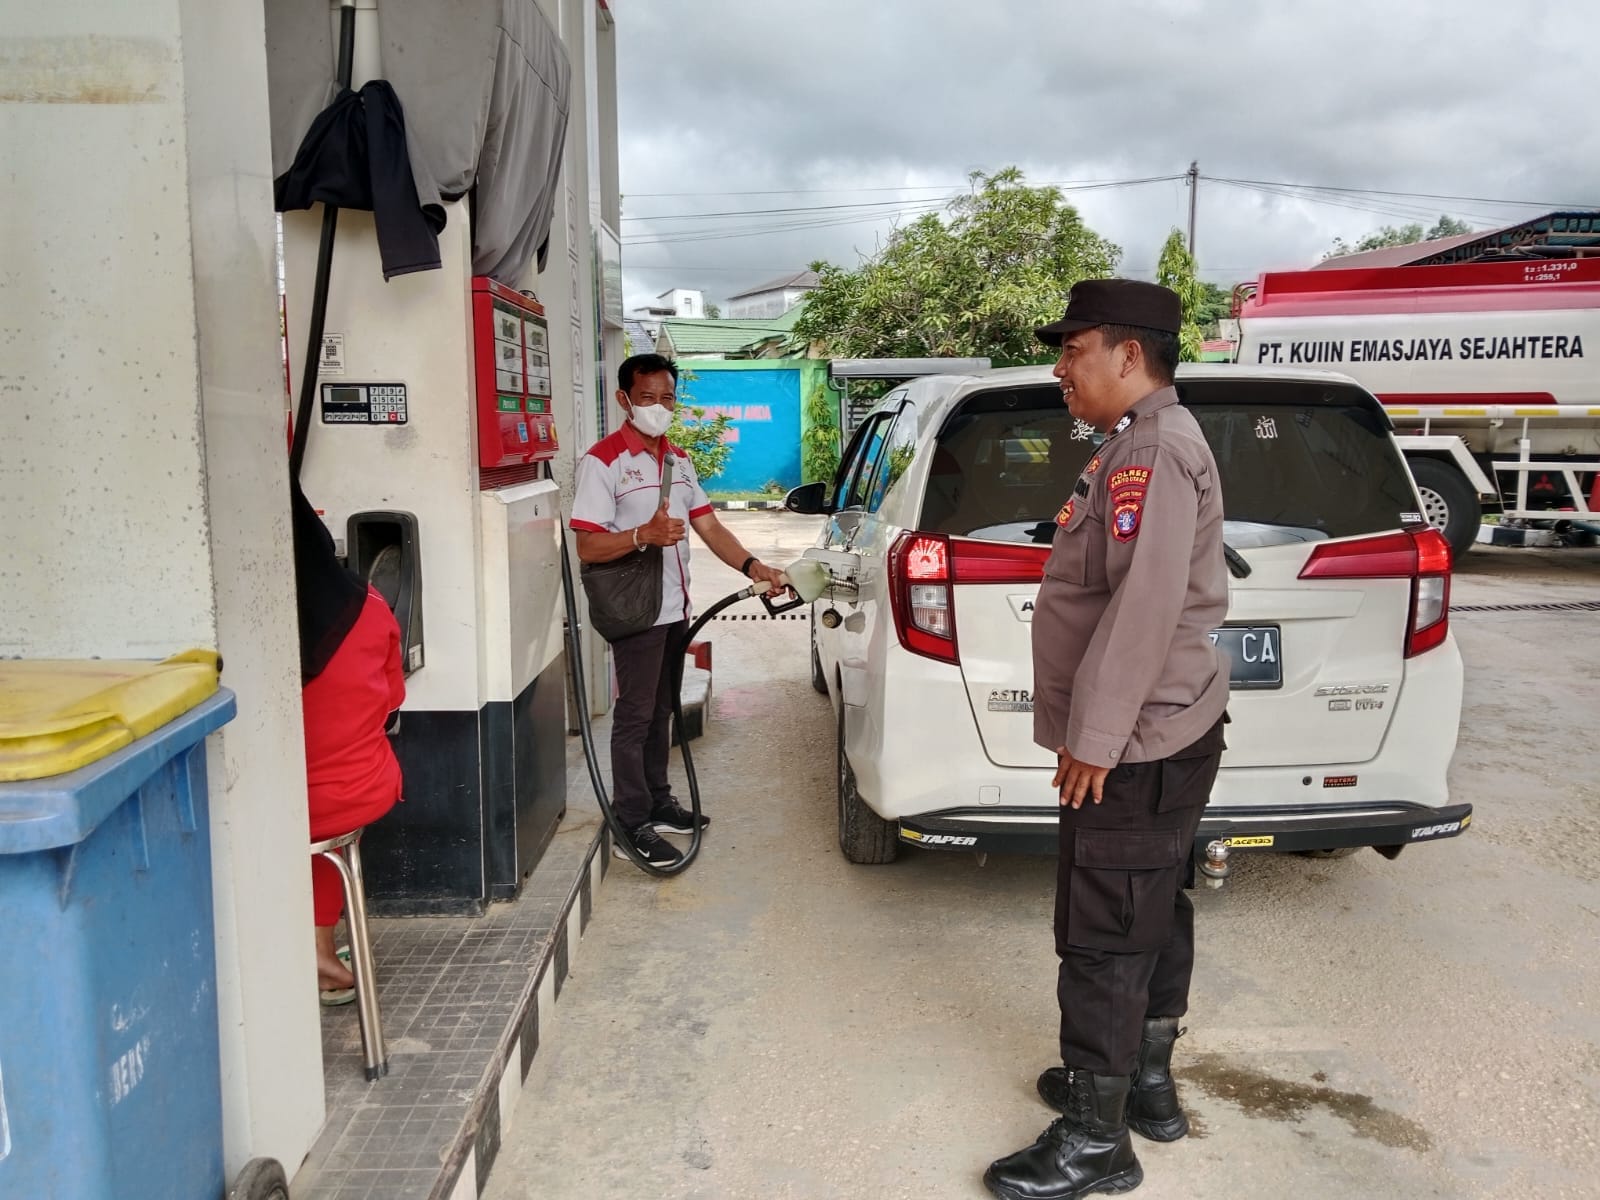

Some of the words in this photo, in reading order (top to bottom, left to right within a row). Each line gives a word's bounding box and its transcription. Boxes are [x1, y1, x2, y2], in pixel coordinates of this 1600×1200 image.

[1258, 343, 1283, 364] PT.
[1290, 341, 1344, 363] KUIIN
[1350, 339, 1453, 362] EMASJAYA
[1459, 335, 1583, 360] SEJAHTERA
[1111, 469, 1149, 482] POLRES
[1242, 632, 1276, 663] CA
[1411, 821, 1461, 838] TAPER
[921, 833, 978, 846] TAPER
